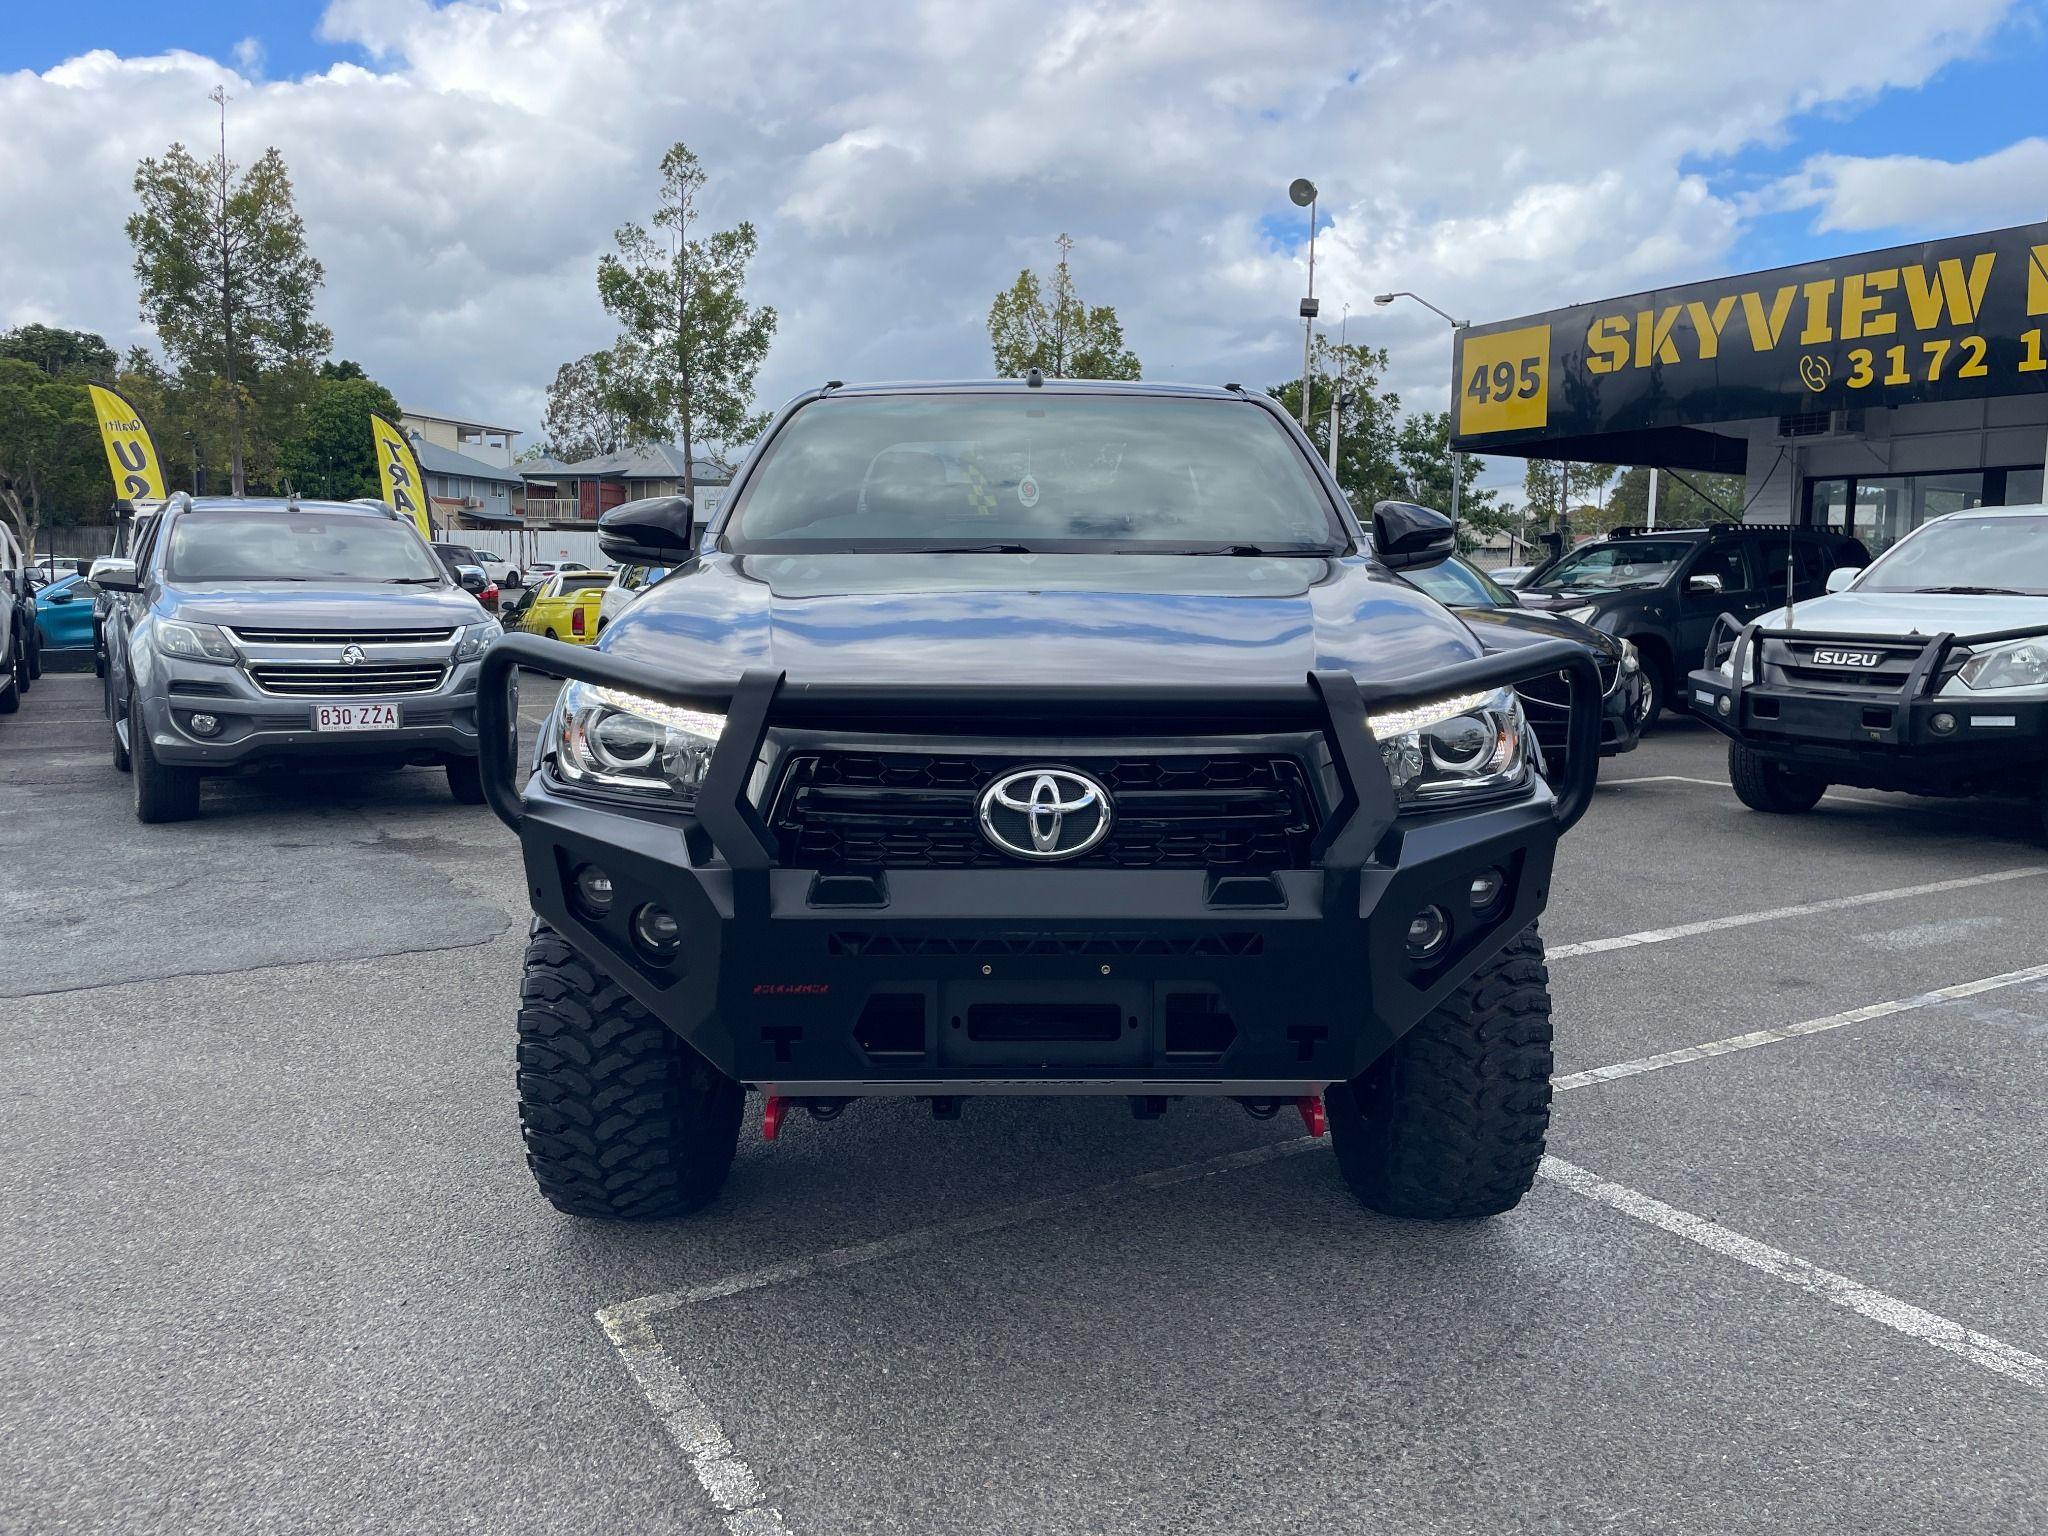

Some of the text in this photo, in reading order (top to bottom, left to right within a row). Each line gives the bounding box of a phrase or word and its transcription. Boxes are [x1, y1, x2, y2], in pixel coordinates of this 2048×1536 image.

[1586, 252, 1997, 374] SKYVIEW
[1467, 356, 1541, 404] 495
[1846, 335, 1988, 388] 3172
[1813, 651, 1877, 666] ISUZU
[320, 707, 395, 725] 830 ZZA
